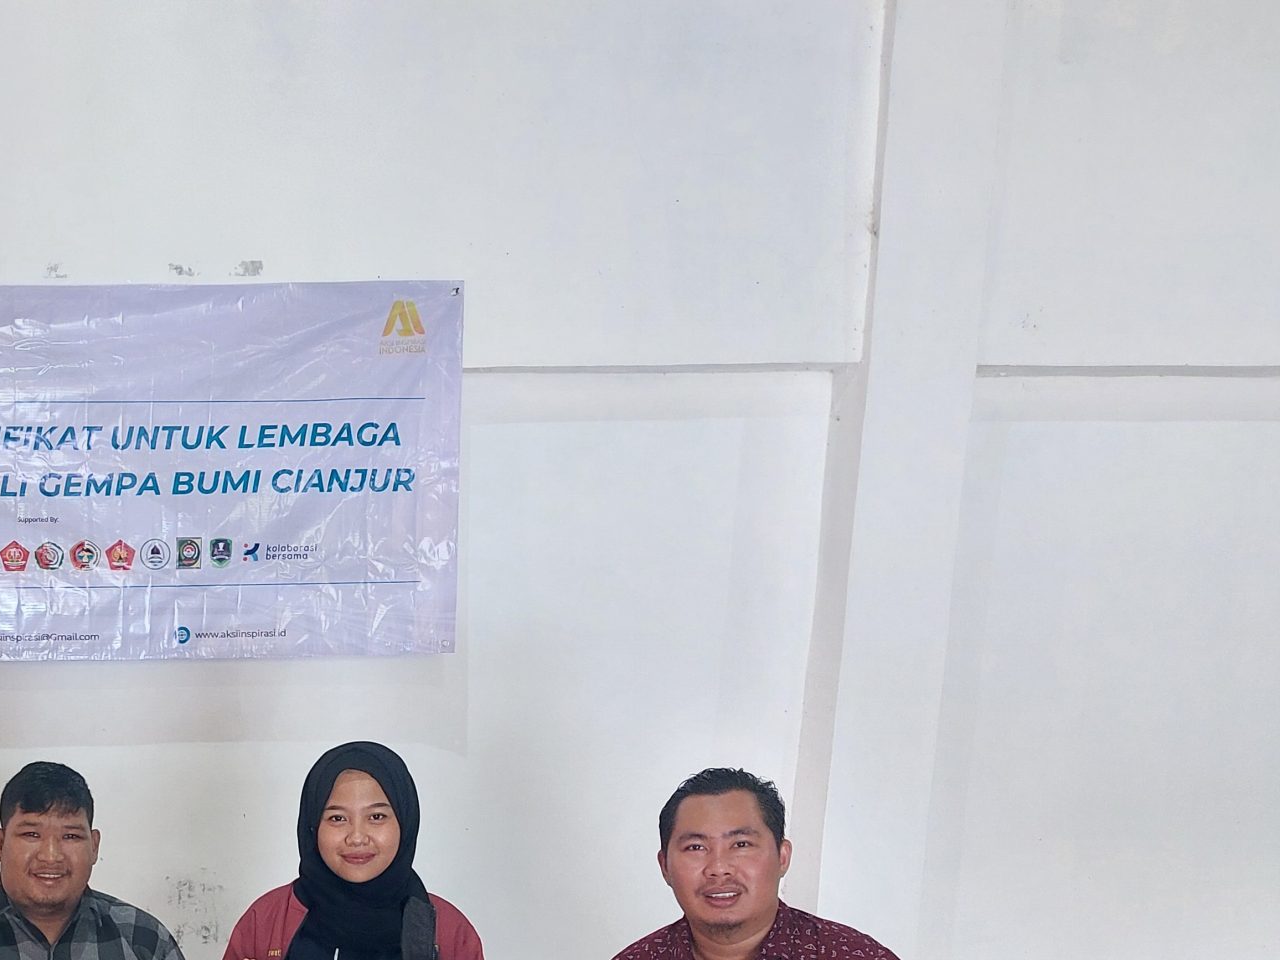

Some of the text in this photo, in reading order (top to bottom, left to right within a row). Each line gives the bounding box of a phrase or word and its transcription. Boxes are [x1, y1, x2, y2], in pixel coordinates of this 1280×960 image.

[111, 425, 229, 450] UNTUK
[238, 422, 401, 449] LEMBAGA
[39, 471, 161, 497] GEMPA
[172, 470, 261, 496] BUMI
[271, 468, 416, 493] CIANJUR
[17, 516, 48, 524] Supported
[266, 544, 318, 553] kolaborasi
[266, 552, 308, 560] bersama
